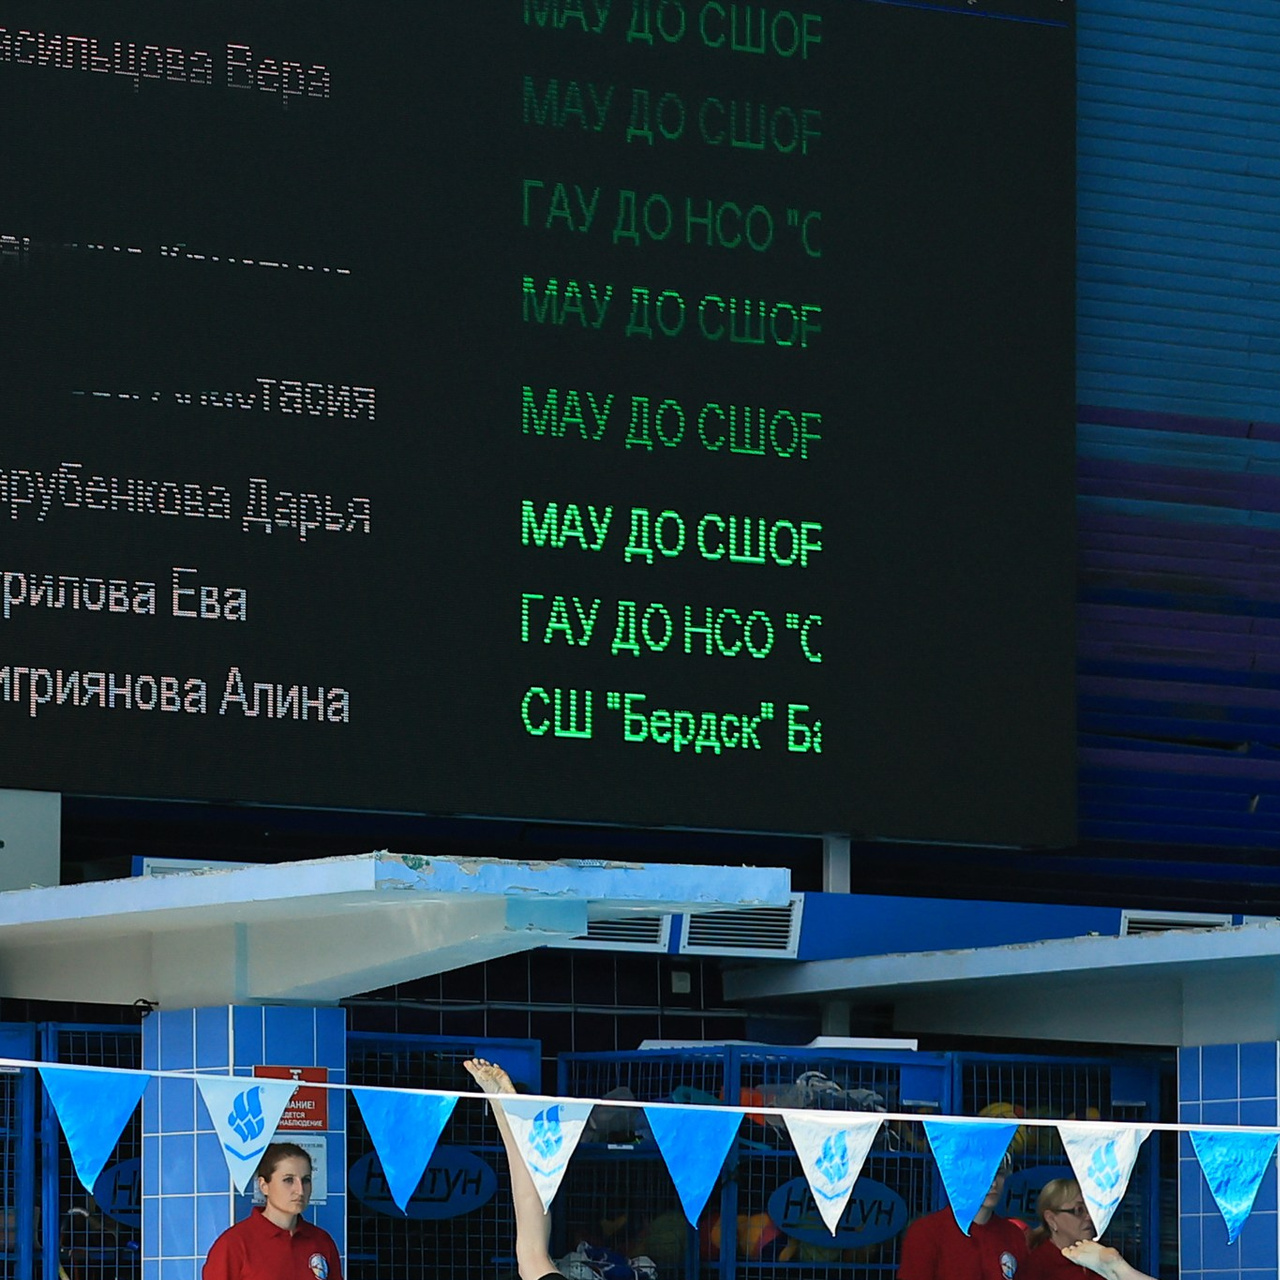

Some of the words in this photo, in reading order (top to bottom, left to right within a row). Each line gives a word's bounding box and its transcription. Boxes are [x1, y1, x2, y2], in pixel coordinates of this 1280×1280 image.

[627, 0, 686, 45] ДО
[227, 44, 330, 110] Вера
[524, 75, 615, 132] МАУ
[626, 88, 686, 145] ДО
[523, 179, 600, 232] ГАУ
[613, 190, 673, 246] ДО
[685, 198, 775, 253] НСО
[523, 275, 614, 329] МАУ
[626, 285, 686, 340] ДО
[522, 386, 615, 440] МАУ
[625, 396, 686, 451] ДО
[242, 477, 372, 542] Дарья
[522, 500, 614, 551] МАУ
[624, 507, 686, 564] ДО
[172, 567, 247, 622] Ева
[521, 593, 601, 647] ГАУ
[611, 600, 674, 657] ДО
[684, 605, 775, 659] НСО
[219, 666, 350, 723] Алина
[521, 686, 593, 740] СШ
[606, 691, 775, 756] "Бердск"
[365, 1157, 483, 1202] НТУН
